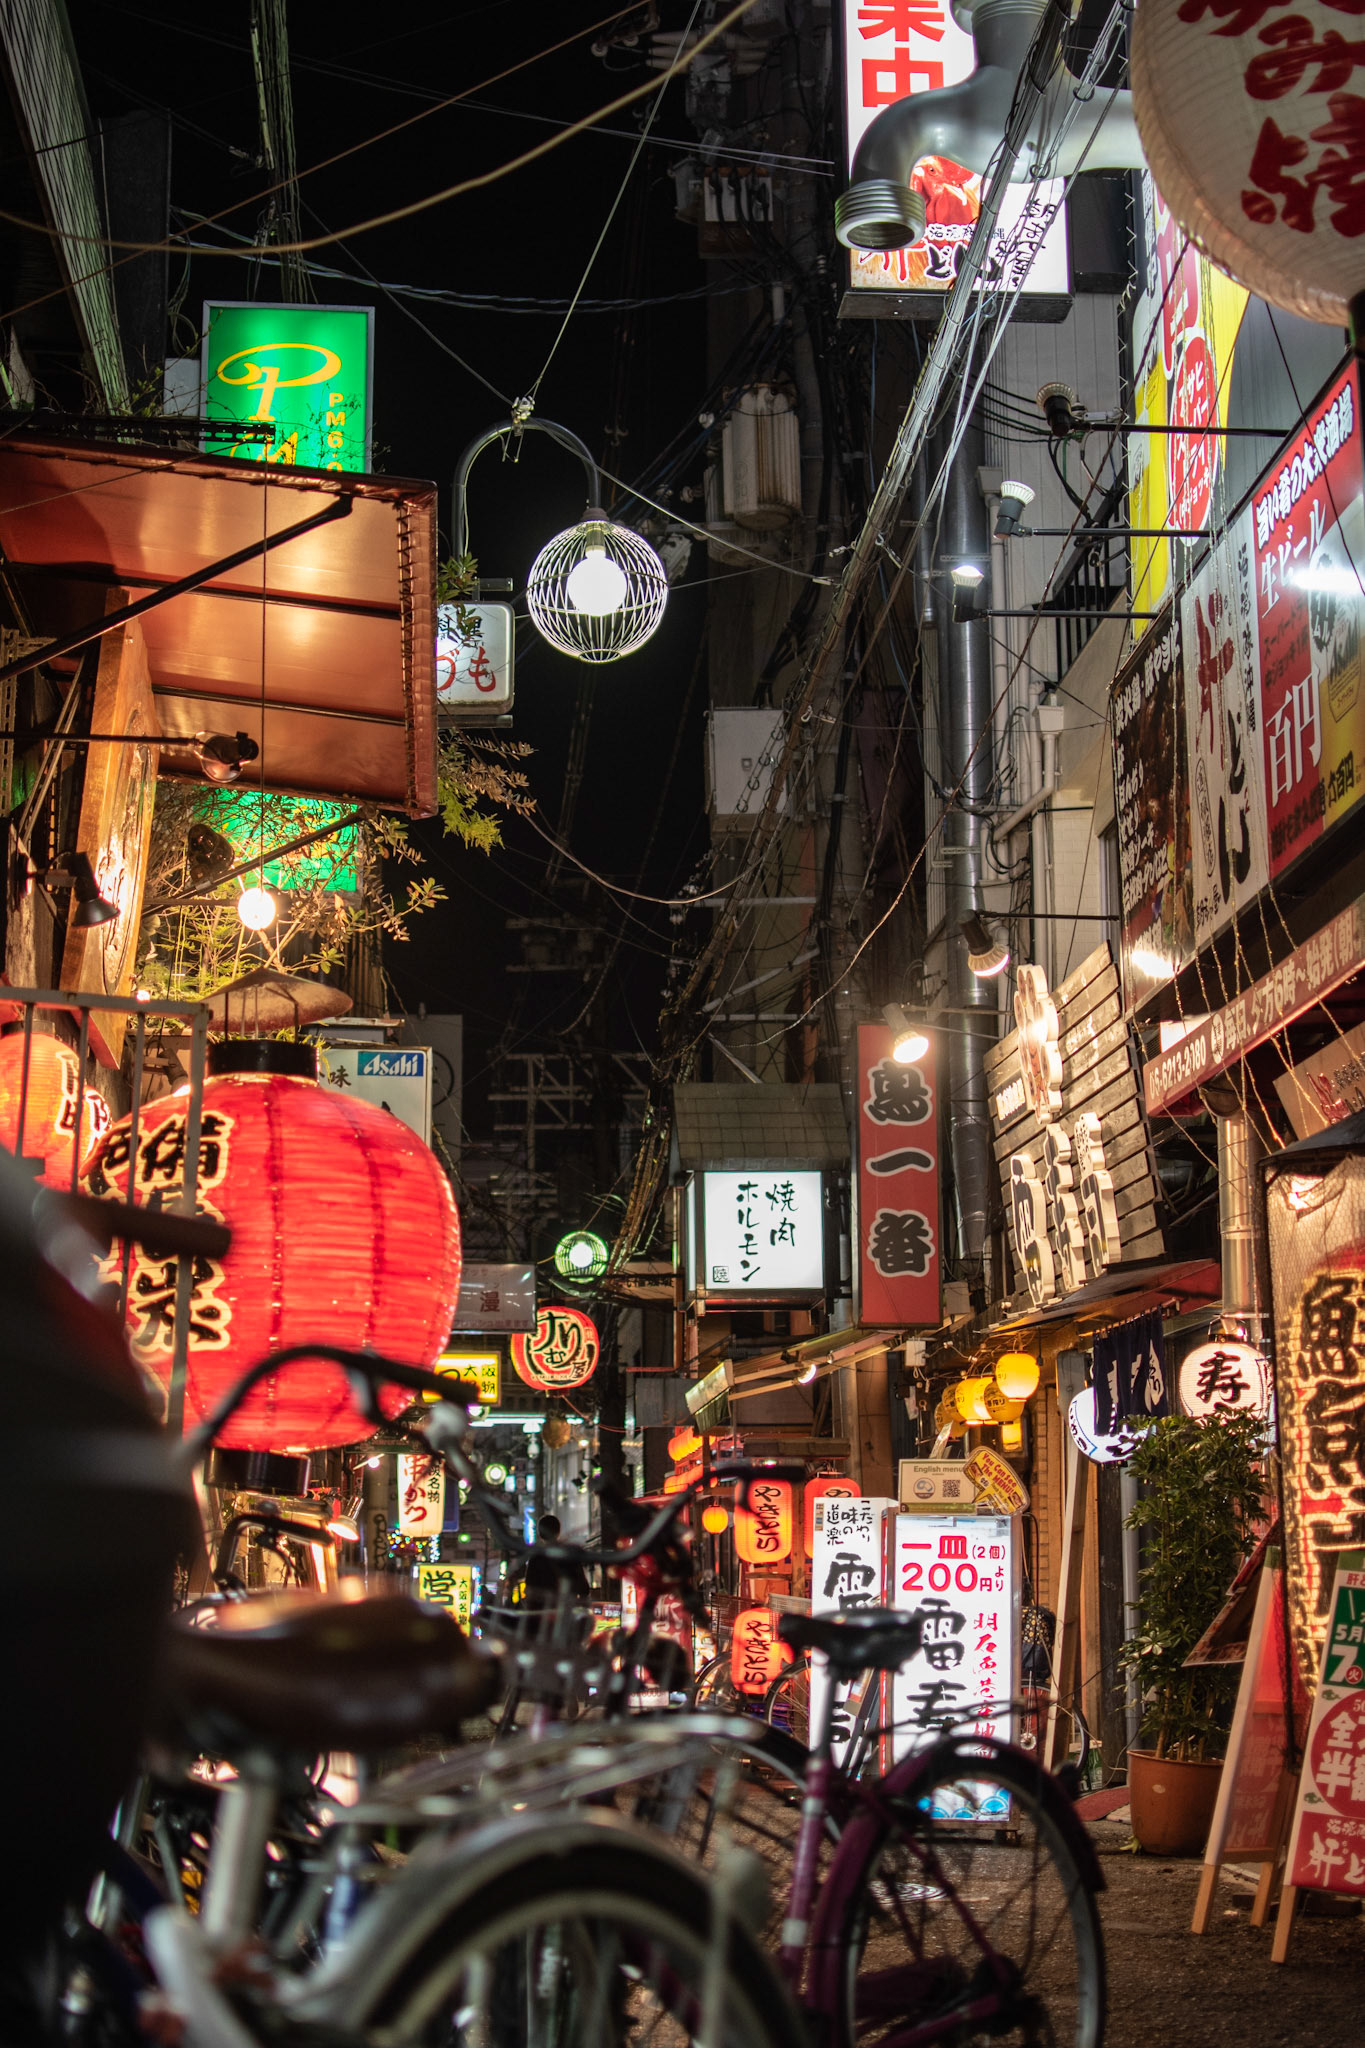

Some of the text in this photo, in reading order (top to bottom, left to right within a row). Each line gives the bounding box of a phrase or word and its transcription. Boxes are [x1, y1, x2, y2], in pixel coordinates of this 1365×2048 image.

[1266, 663, 1323, 809] 百円
[363, 1054, 418, 1076] Asahi
[736, 1180, 761, 1282] ホルモン
[765, 1180, 798, 1247] 焼肉
[1196, 1351, 1254, 1411] 寿
[914, 1466, 941, 1475] English
[827, 1504, 845, 1546] 道楽
[841, 1506, 859, 1535] 味の
[901, 1535, 969, 1560] 一皿
[1328, 1645, 1359, 1682] 7
